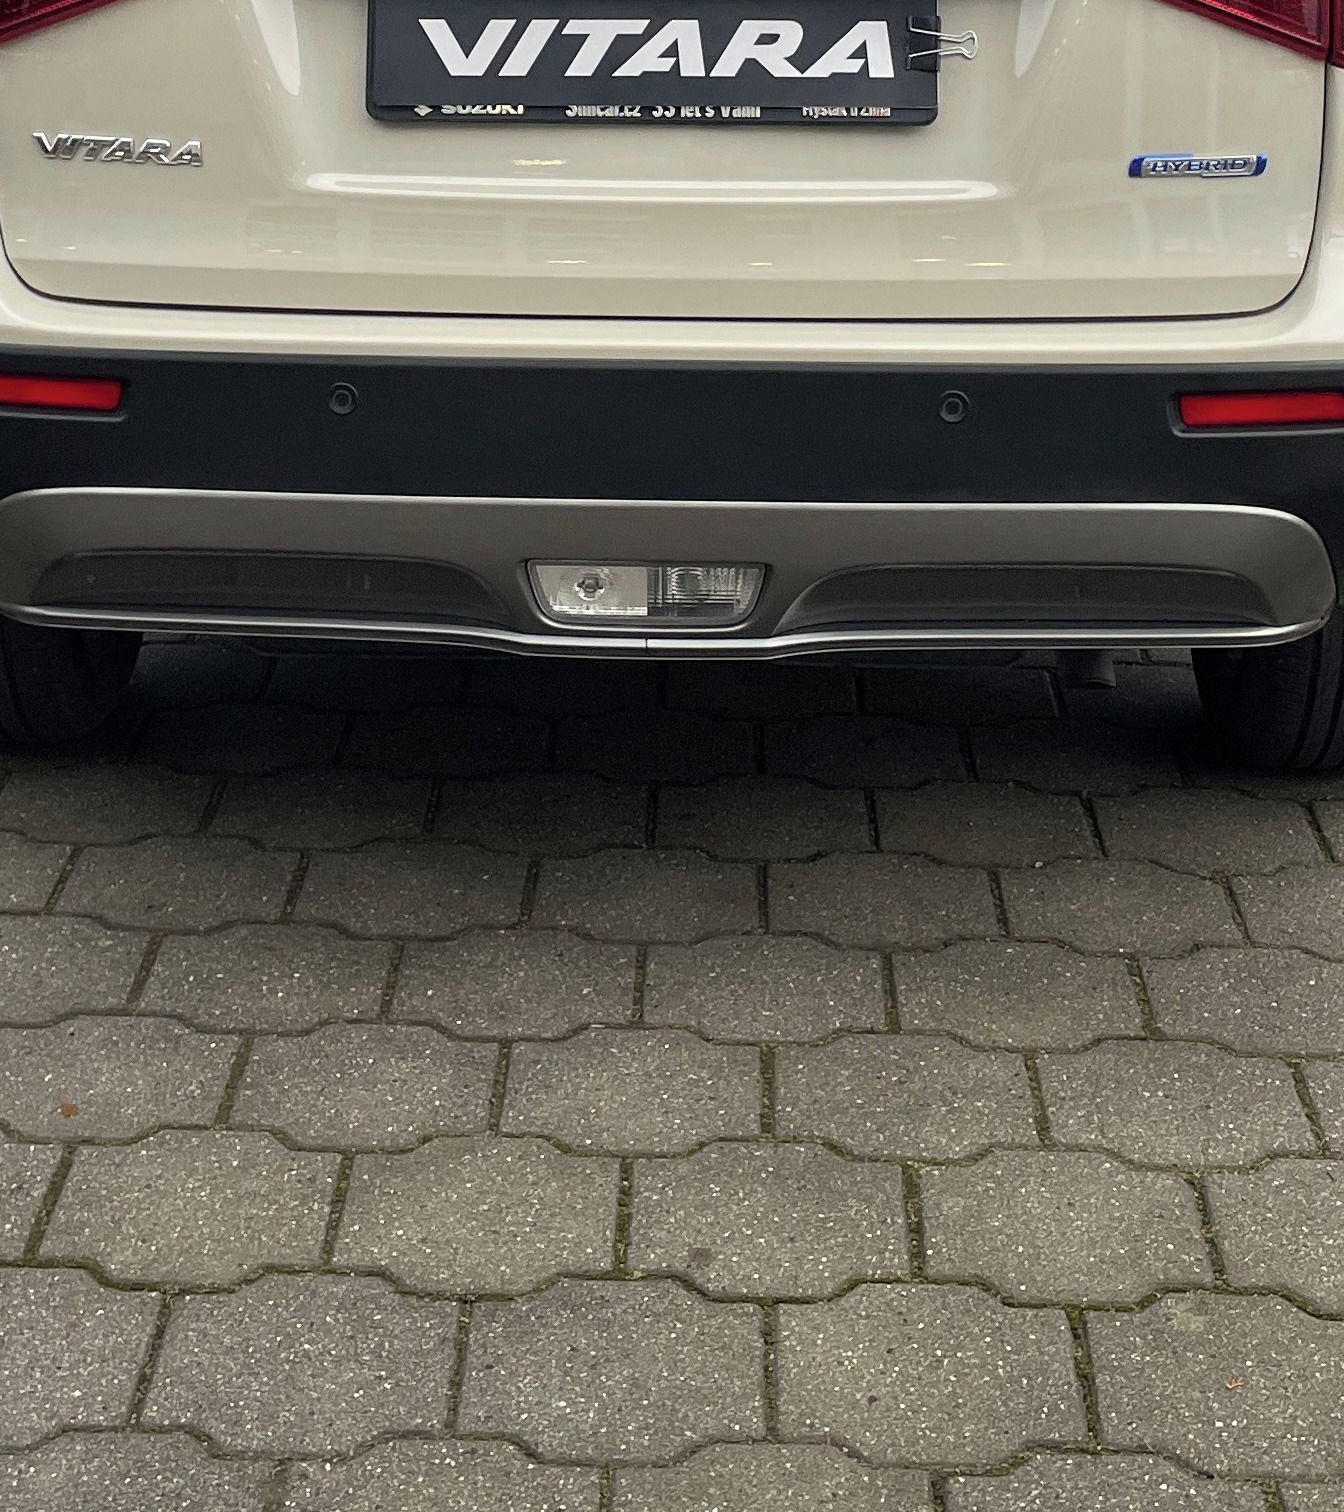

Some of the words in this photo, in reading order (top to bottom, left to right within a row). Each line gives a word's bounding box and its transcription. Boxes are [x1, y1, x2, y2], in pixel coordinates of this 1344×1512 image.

[418, 19, 895, 78] VITARA
[32, 130, 205, 167] VITARA
[1150, 158, 1249, 174] HYBRID
